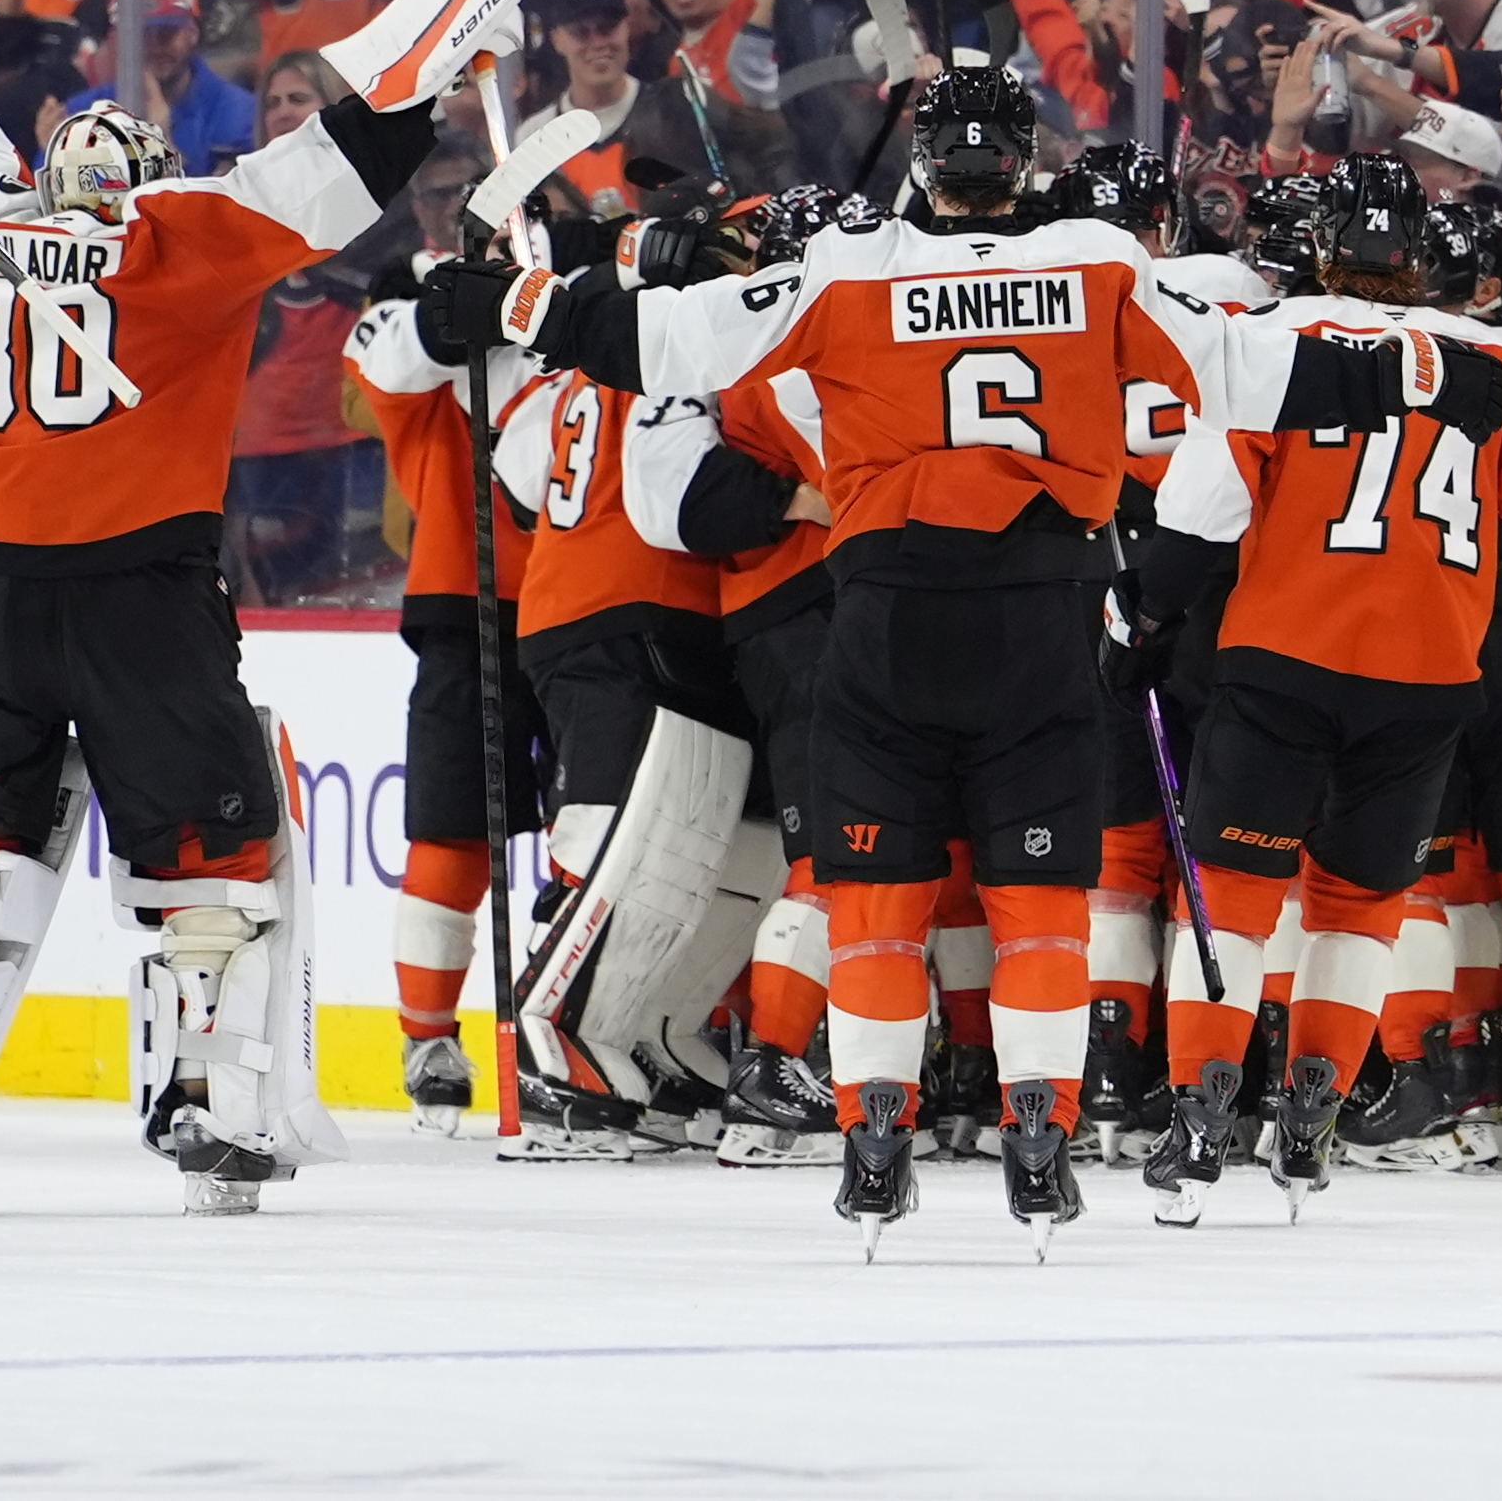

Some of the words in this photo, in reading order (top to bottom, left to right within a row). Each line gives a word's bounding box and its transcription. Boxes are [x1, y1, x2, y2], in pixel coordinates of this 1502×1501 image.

[966, 121, 982, 146] 6
[1092, 182, 1120, 207] 55
[1365, 207, 1390, 232] 74
[1446, 232, 1469, 258] 39
[907, 279, 1071, 333] SANHEIM
[941, 345, 1049, 459] 6
[1309, 413, 1482, 577] 74
[1219, 825, 1303, 851] BAUER
[542, 896, 610, 1005] TRUE
[302, 948, 313, 1072] SUPREME
